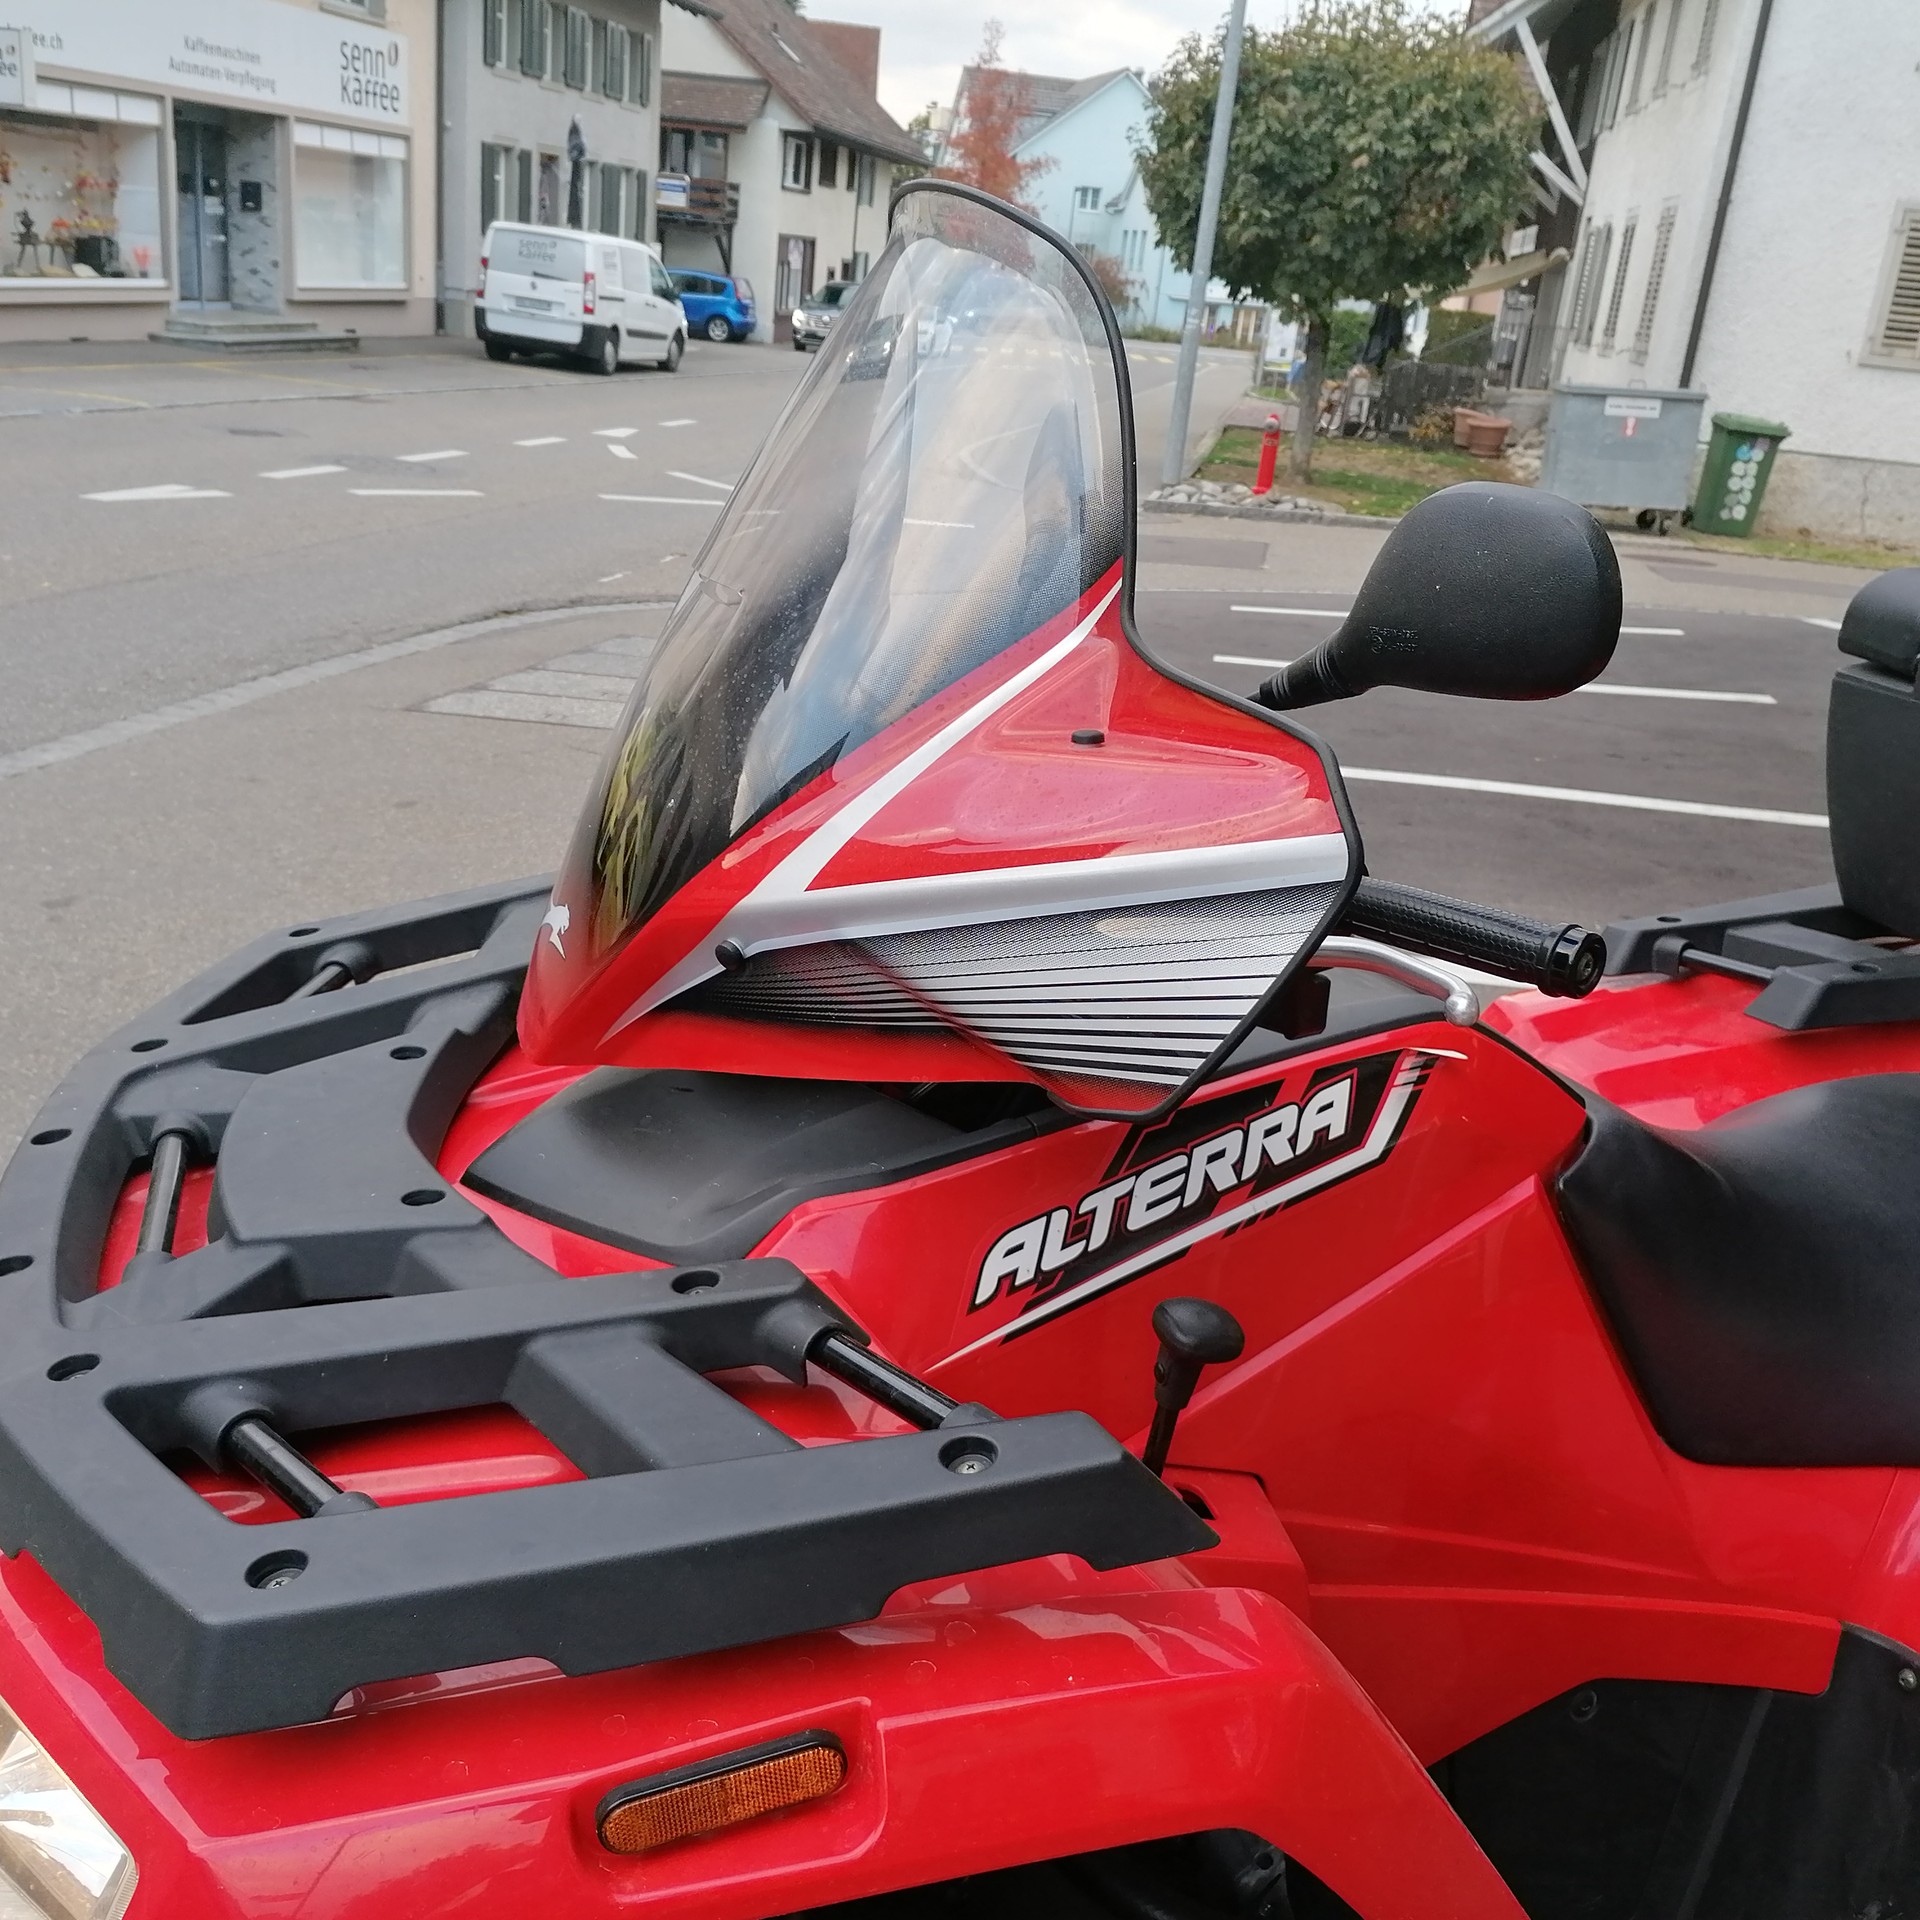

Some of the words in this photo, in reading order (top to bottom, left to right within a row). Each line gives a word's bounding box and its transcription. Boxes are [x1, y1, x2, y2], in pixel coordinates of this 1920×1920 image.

[183, 35, 261, 65] Kaffeemaschinen
[340, 41, 385, 79] senn
[975, 1077, 1352, 1305] ALTERRA
